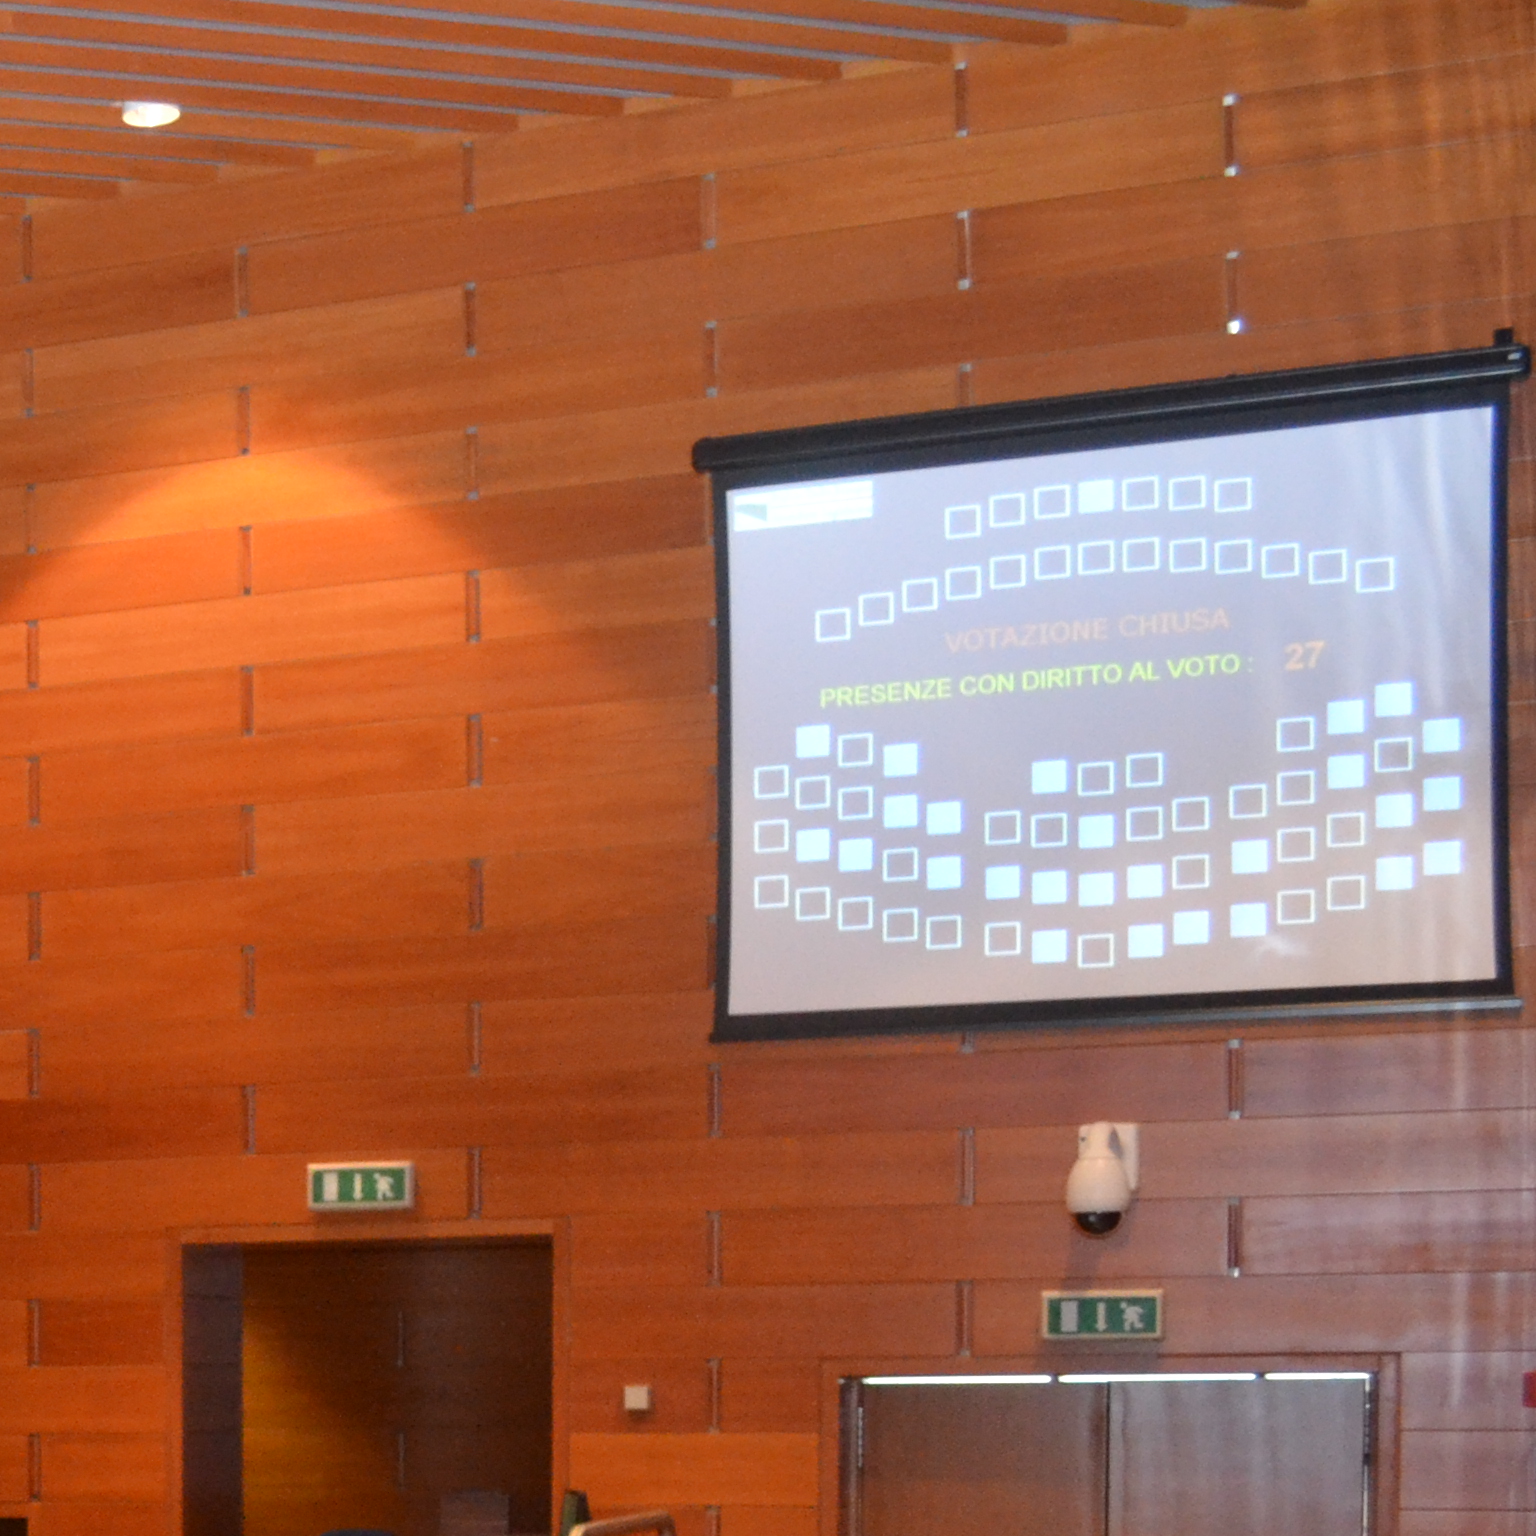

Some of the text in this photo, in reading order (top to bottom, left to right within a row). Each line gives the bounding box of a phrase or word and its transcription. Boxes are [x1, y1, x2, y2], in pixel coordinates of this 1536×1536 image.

[945, 607, 1231, 653] VOTAZIONE CHIUSA
[1283, 640, 1326, 671] 27
[819, 676, 953, 709] PRESENZE
[959, 672, 1015, 696] CON
[1021, 663, 1123, 692] DIRITTO
[1128, 660, 1161, 683] AL
[1166, 653, 1241, 679] VOTO
